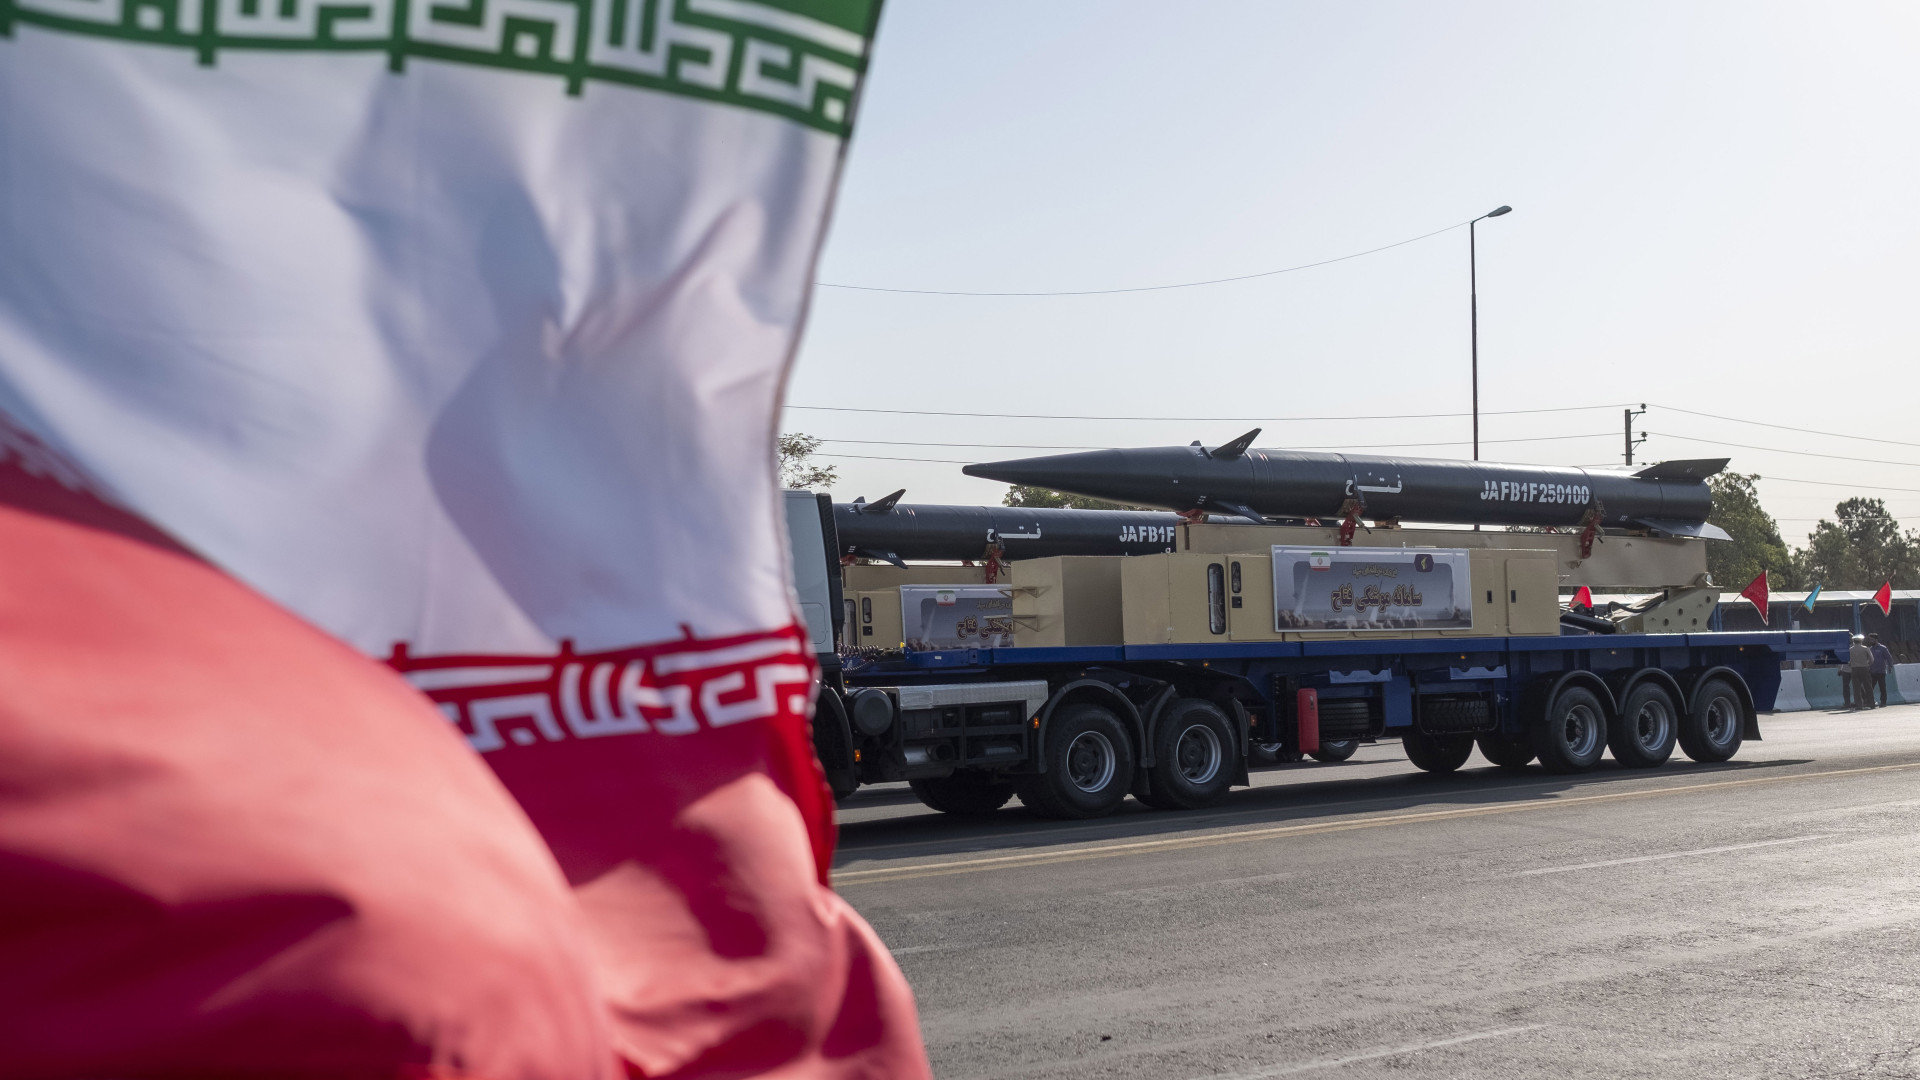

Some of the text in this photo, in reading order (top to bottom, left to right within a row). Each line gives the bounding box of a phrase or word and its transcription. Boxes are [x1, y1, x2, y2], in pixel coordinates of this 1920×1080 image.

[1480, 480, 1590, 505] JAFB1F250100
[1331, 583, 1422, 613] سامانه موشکی فتاح
[956, 615, 978, 640] فتاح
